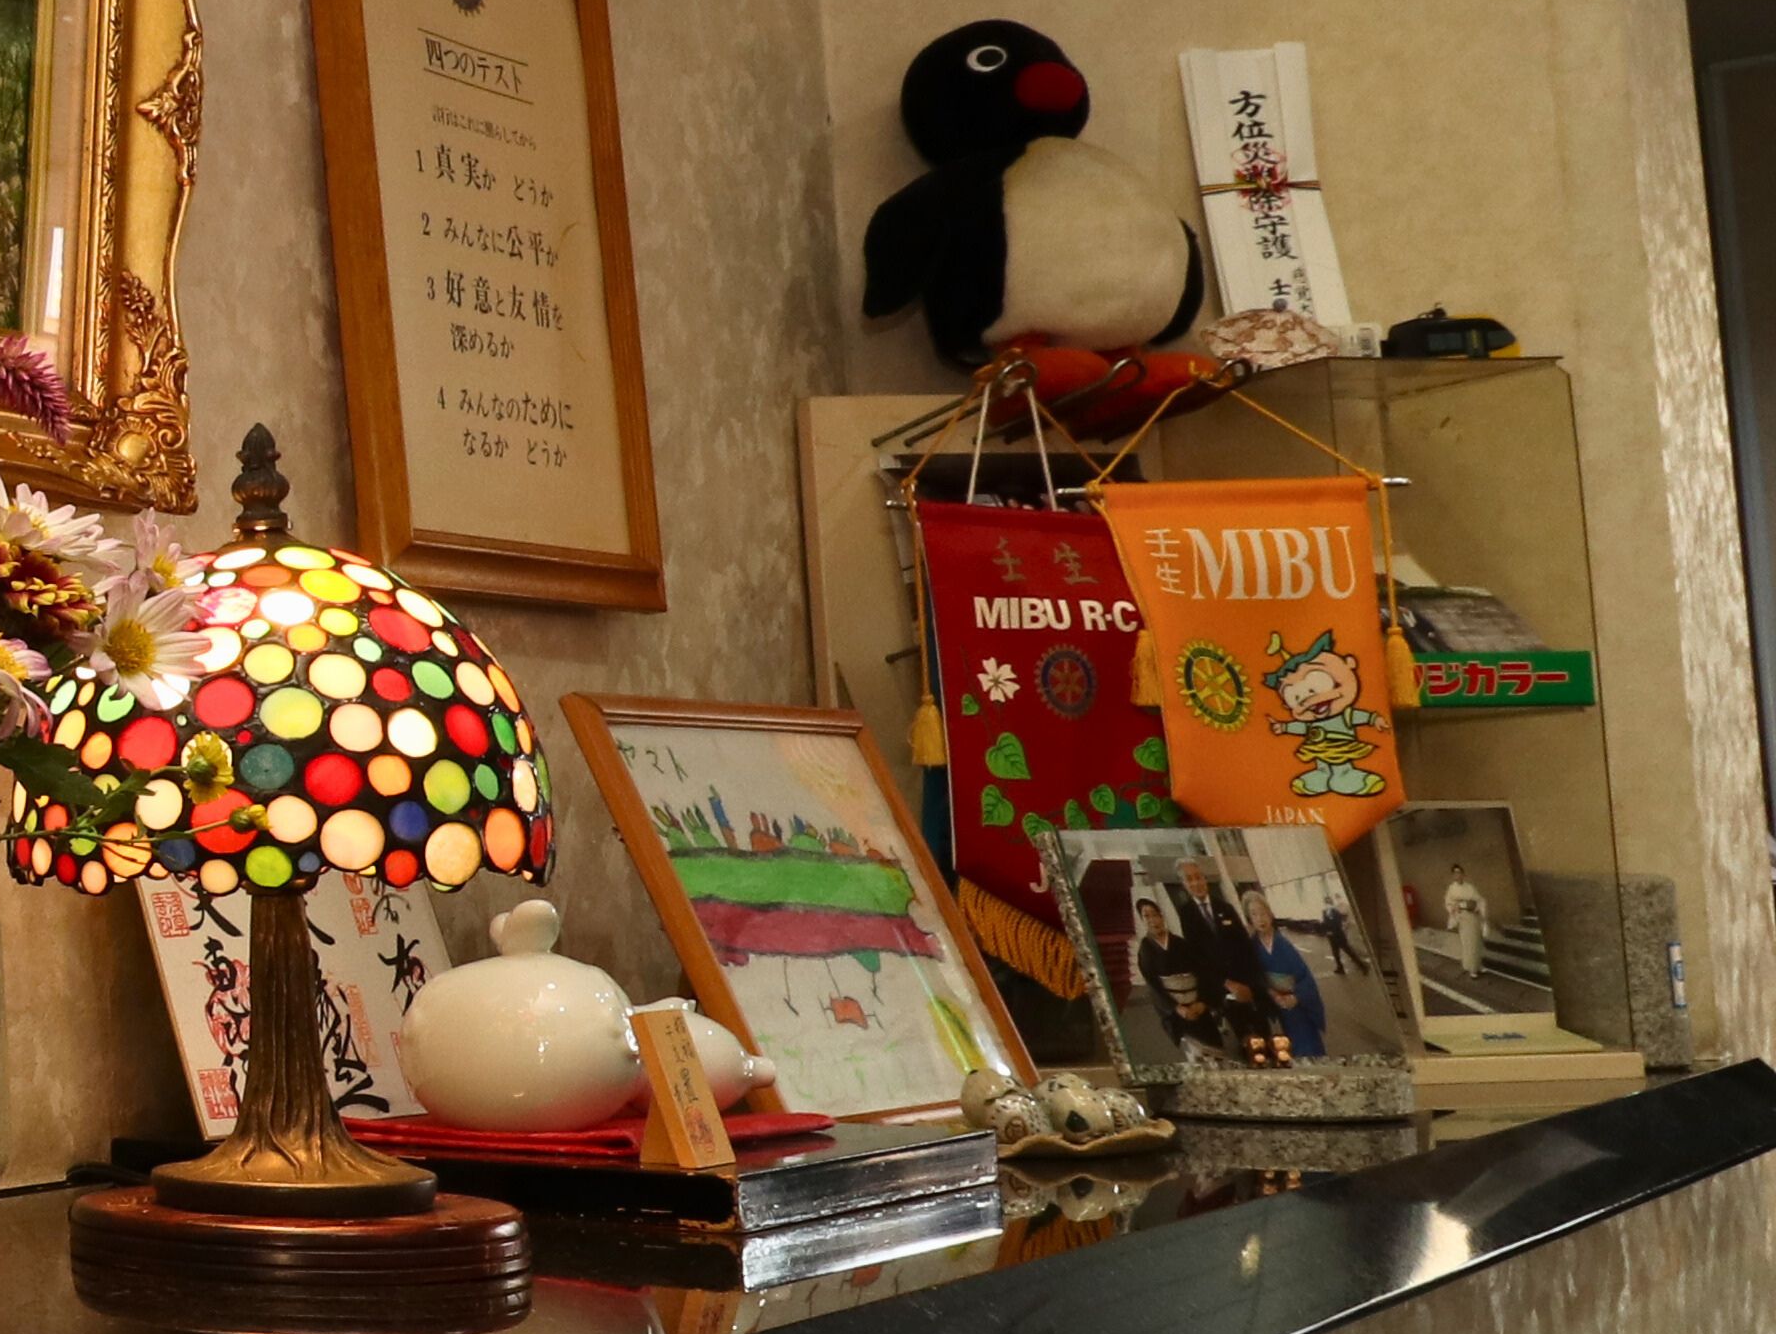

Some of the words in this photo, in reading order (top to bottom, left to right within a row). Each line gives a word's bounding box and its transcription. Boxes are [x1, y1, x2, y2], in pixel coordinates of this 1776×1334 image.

[424, 37, 523, 94] 四つのテスト
[415, 149, 425, 173] 1
[435, 143, 496, 191] 真実か
[513, 175, 554, 208] どうか
[421, 212, 431, 236] 2
[444, 217, 559, 267] みんなに公平か
[426, 276, 436, 300] 3
[445, 269, 564, 331] 好意と友情を
[450, 322, 515, 359] 深めるか
[437, 386, 446, 409] 4
[459, 388, 574, 430] みんなのために
[463, 428, 510, 458] なるか
[527, 437, 567, 468] どうか
[1182, 526, 1358, 601] MIBU
[974, 596, 1072, 631] MIBU
[1262, 805, 1326, 825] JAPAN
